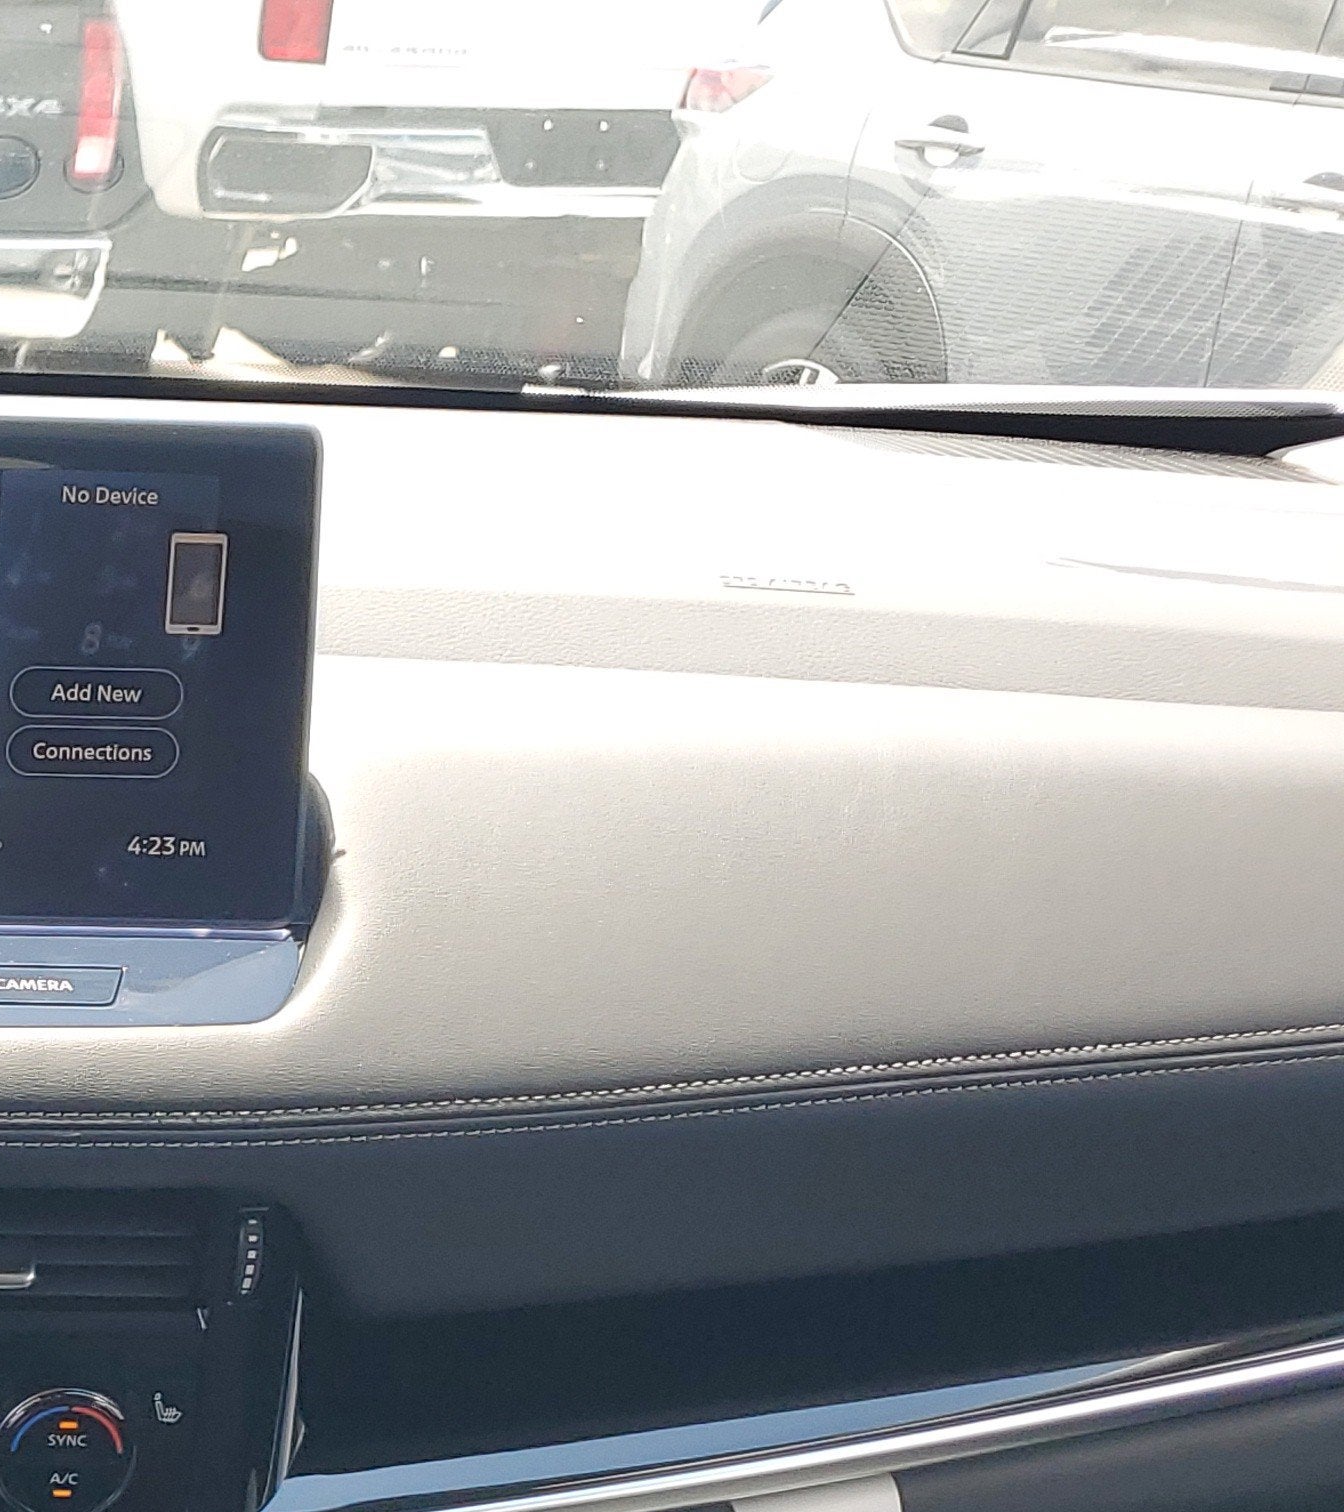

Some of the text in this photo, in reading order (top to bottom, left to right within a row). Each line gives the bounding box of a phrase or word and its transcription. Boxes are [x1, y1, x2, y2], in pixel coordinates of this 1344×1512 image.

[61, 486, 159, 505] No Device
[50, 683, 142, 702] Add New
[33, 742, 152, 761] Connections
[127, 836, 206, 856] 4:23 PM
[47, 1433, 87, 1447] SYNC
[50, 1472, 79, 1485] A/C
